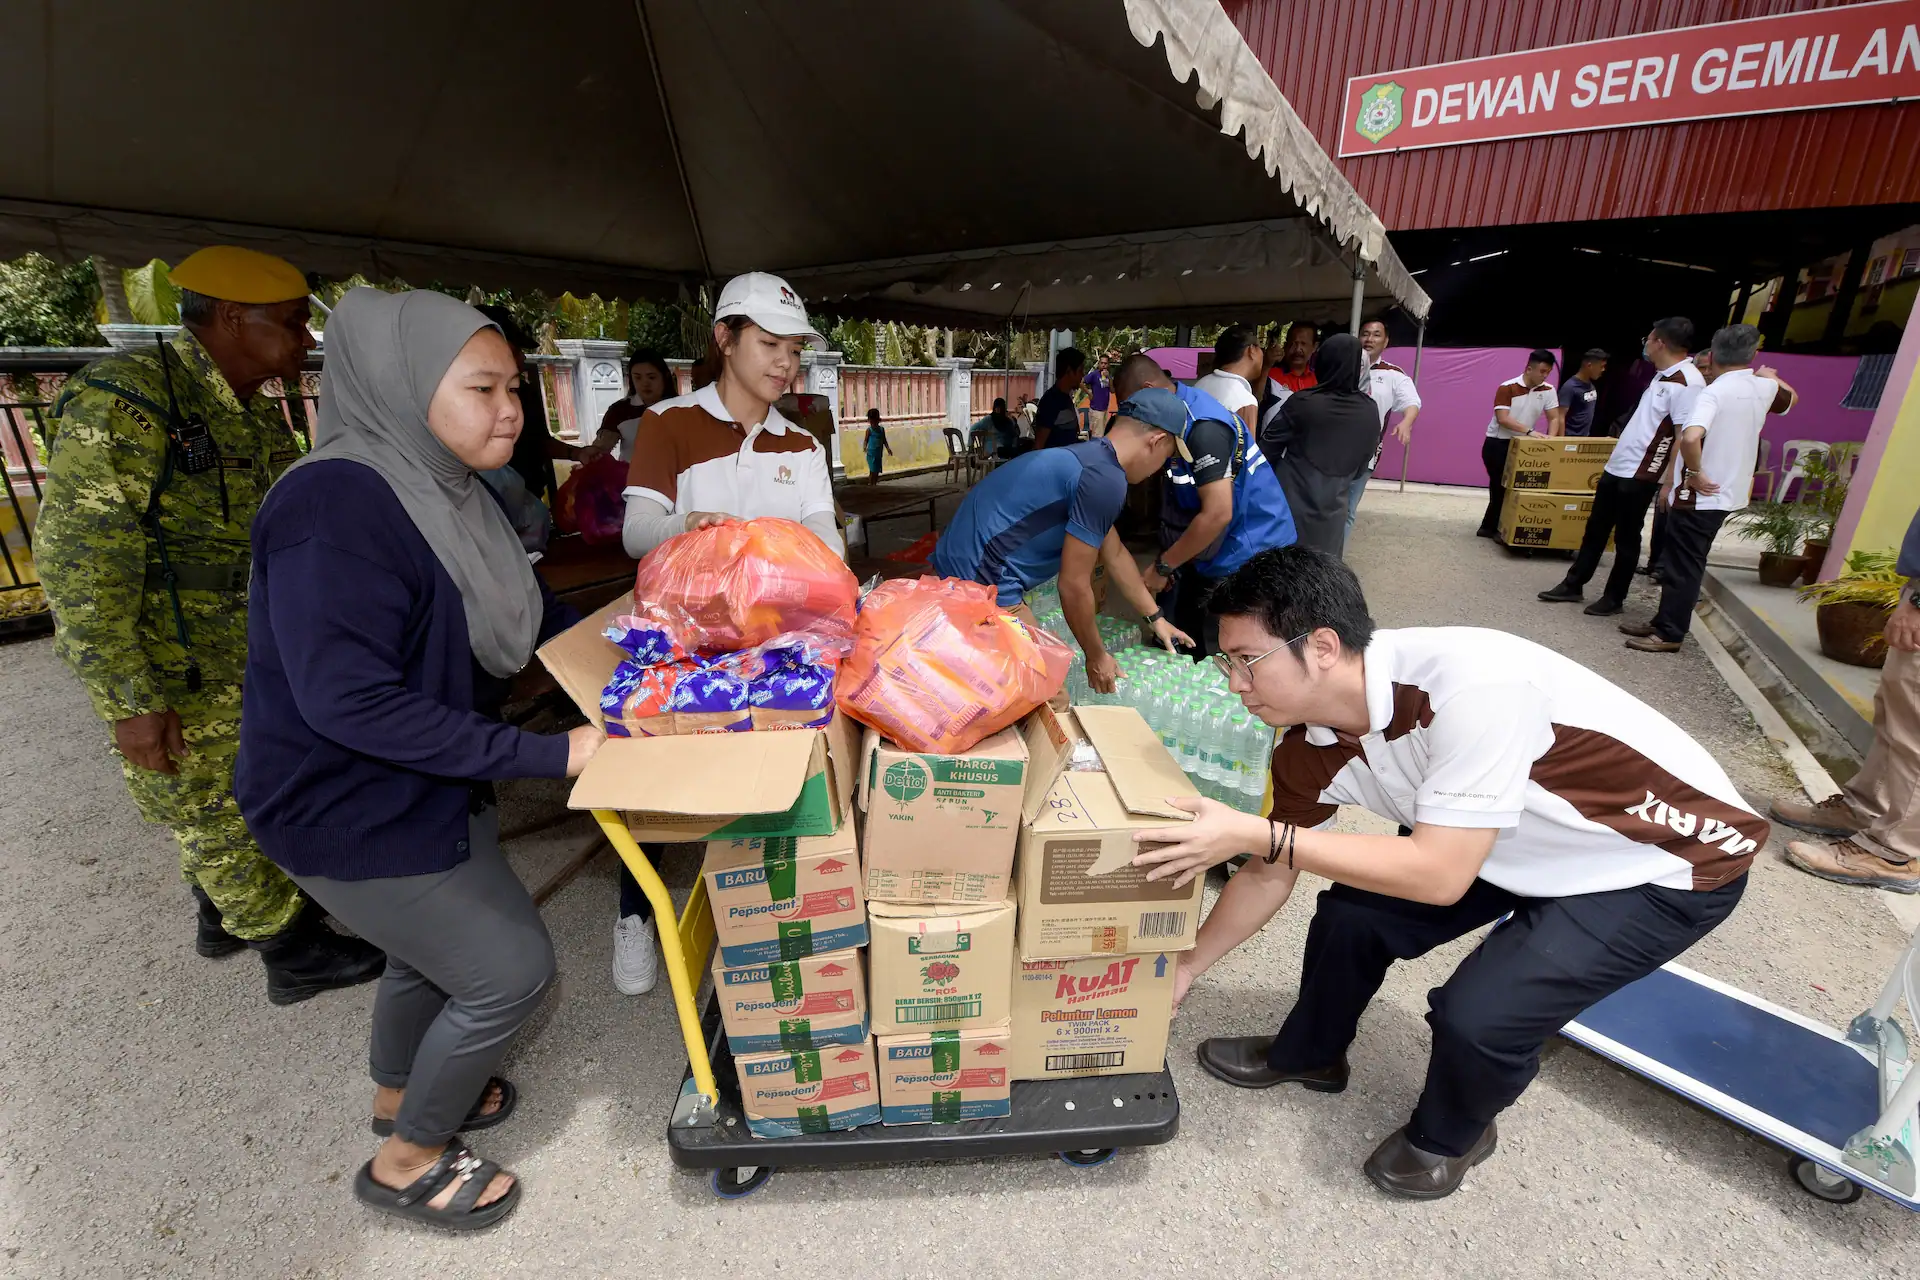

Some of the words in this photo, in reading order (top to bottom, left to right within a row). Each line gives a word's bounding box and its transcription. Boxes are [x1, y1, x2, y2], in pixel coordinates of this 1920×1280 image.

[1410, 70, 1560, 128] DEWAN
[1570, 53, 1680, 108] SERI
[117, 401, 149, 429] RELA
[1647, 435, 1674, 474] MATRIX
[1518, 459, 1551, 468] Value
[773, 477, 796, 486] MATRIX
[1518, 514, 1552, 525] Value
[955, 758, 996, 771] HARGA
[883, 770, 928, 790] Dettol
[949, 771, 999, 783] KHUSUS
[888, 813, 914, 822] YAKIN
[1624, 789, 1758, 856] MARIX
[725, 869, 766, 886] BARU
[729, 900, 796, 919] Pepsodent
[731, 970, 770, 983] BARU
[778, 960, 796, 1001] Unileve
[935, 986, 957, 995] ROS
[1067, 986, 1128, 1004] Harimau
[735, 998, 798, 1012] Pepsodent
[944, 995, 968, 1003] 850gm
[1040, 1009, 1095, 1023] Peluntur
[1096, 1007, 1138, 1020] Lemon
[1056, 1027, 1062, 1036] 6
[1073, 1026, 1102, 1035] 900ml
[1113, 1025, 1120, 1033] 2
[895, 1047, 932, 1058] BARU
[753, 1060, 790, 1074] BARU
[895, 1072, 954, 1084] Pepsodent
[756, 1084, 816, 1099] Pepsodent
